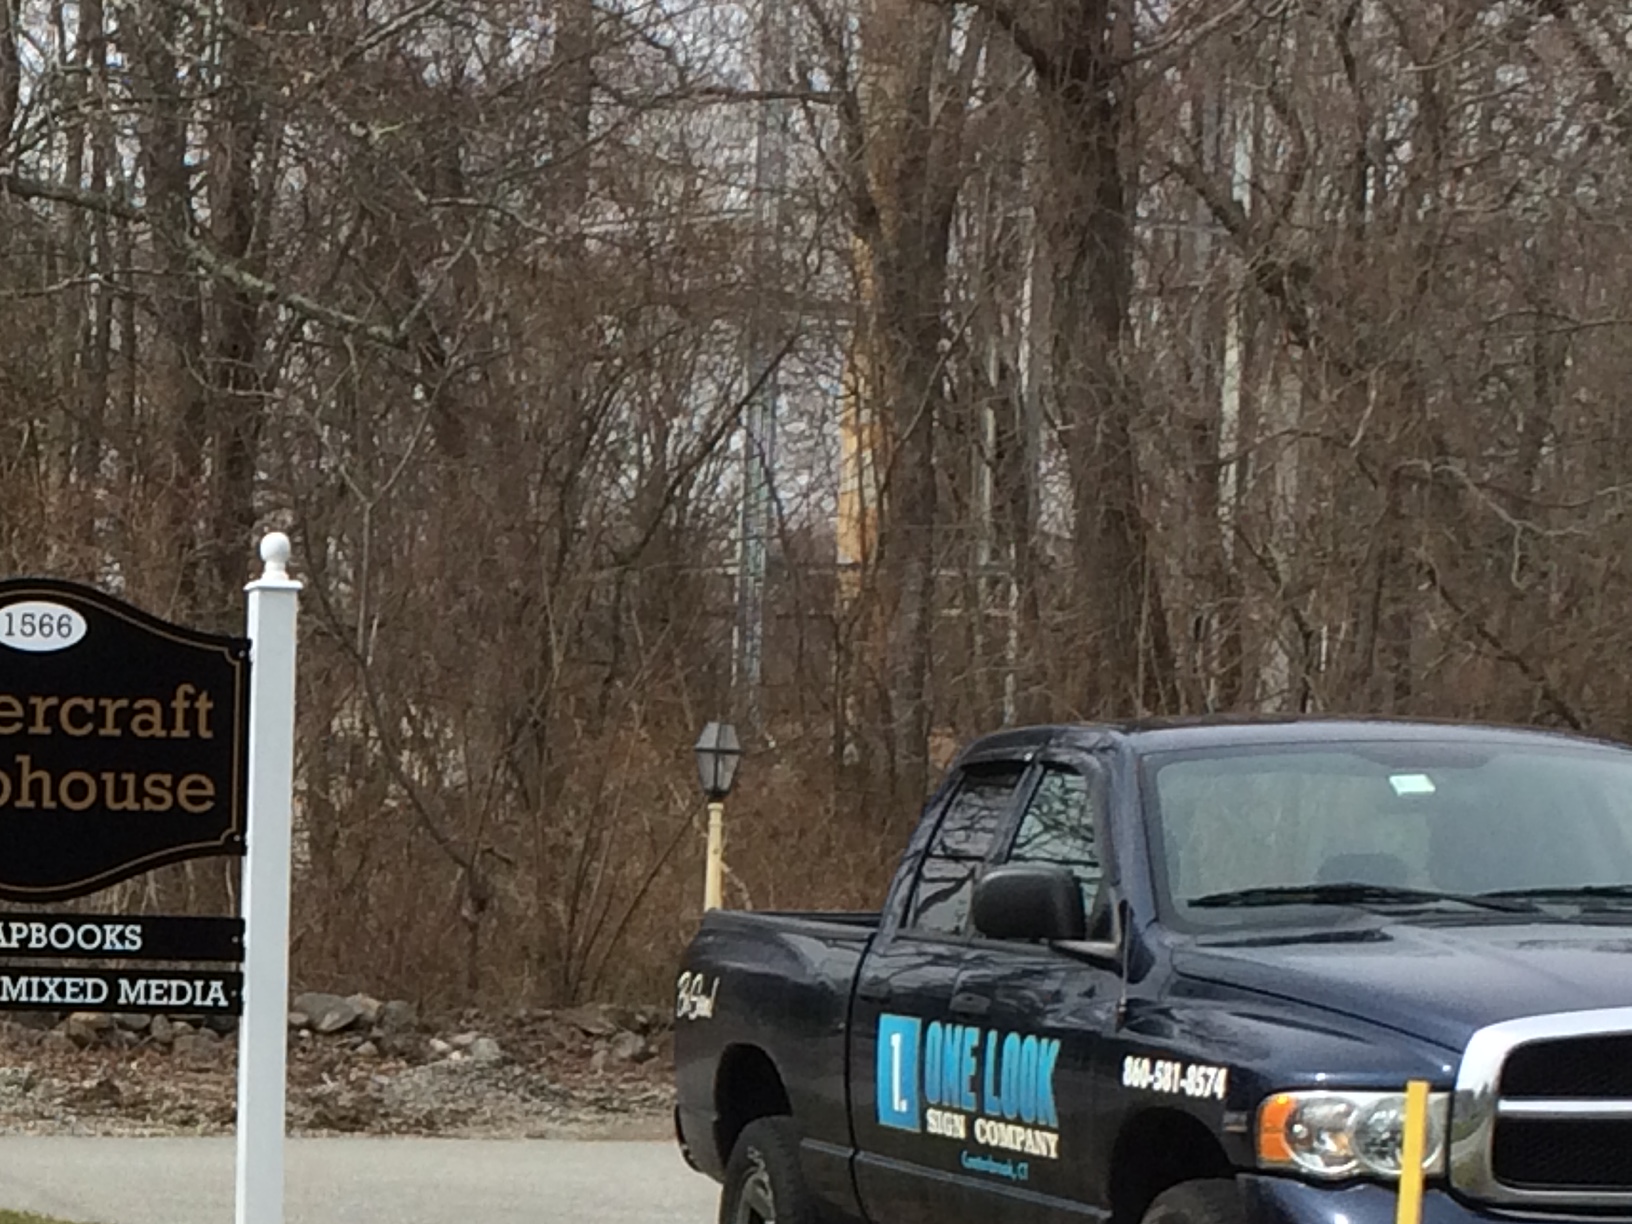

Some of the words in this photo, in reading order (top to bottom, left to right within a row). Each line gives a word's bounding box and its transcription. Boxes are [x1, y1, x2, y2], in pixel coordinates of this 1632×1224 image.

[3, 611, 73, 638] 1566
[117, 978, 229, 1008] MEDIA
[924, 1020, 980, 1112] ONE
[984, 1029, 1061, 1129] LOOK
[925, 1107, 966, 1139] SIGN
[974, 1117, 1059, 1160] COMPANY
